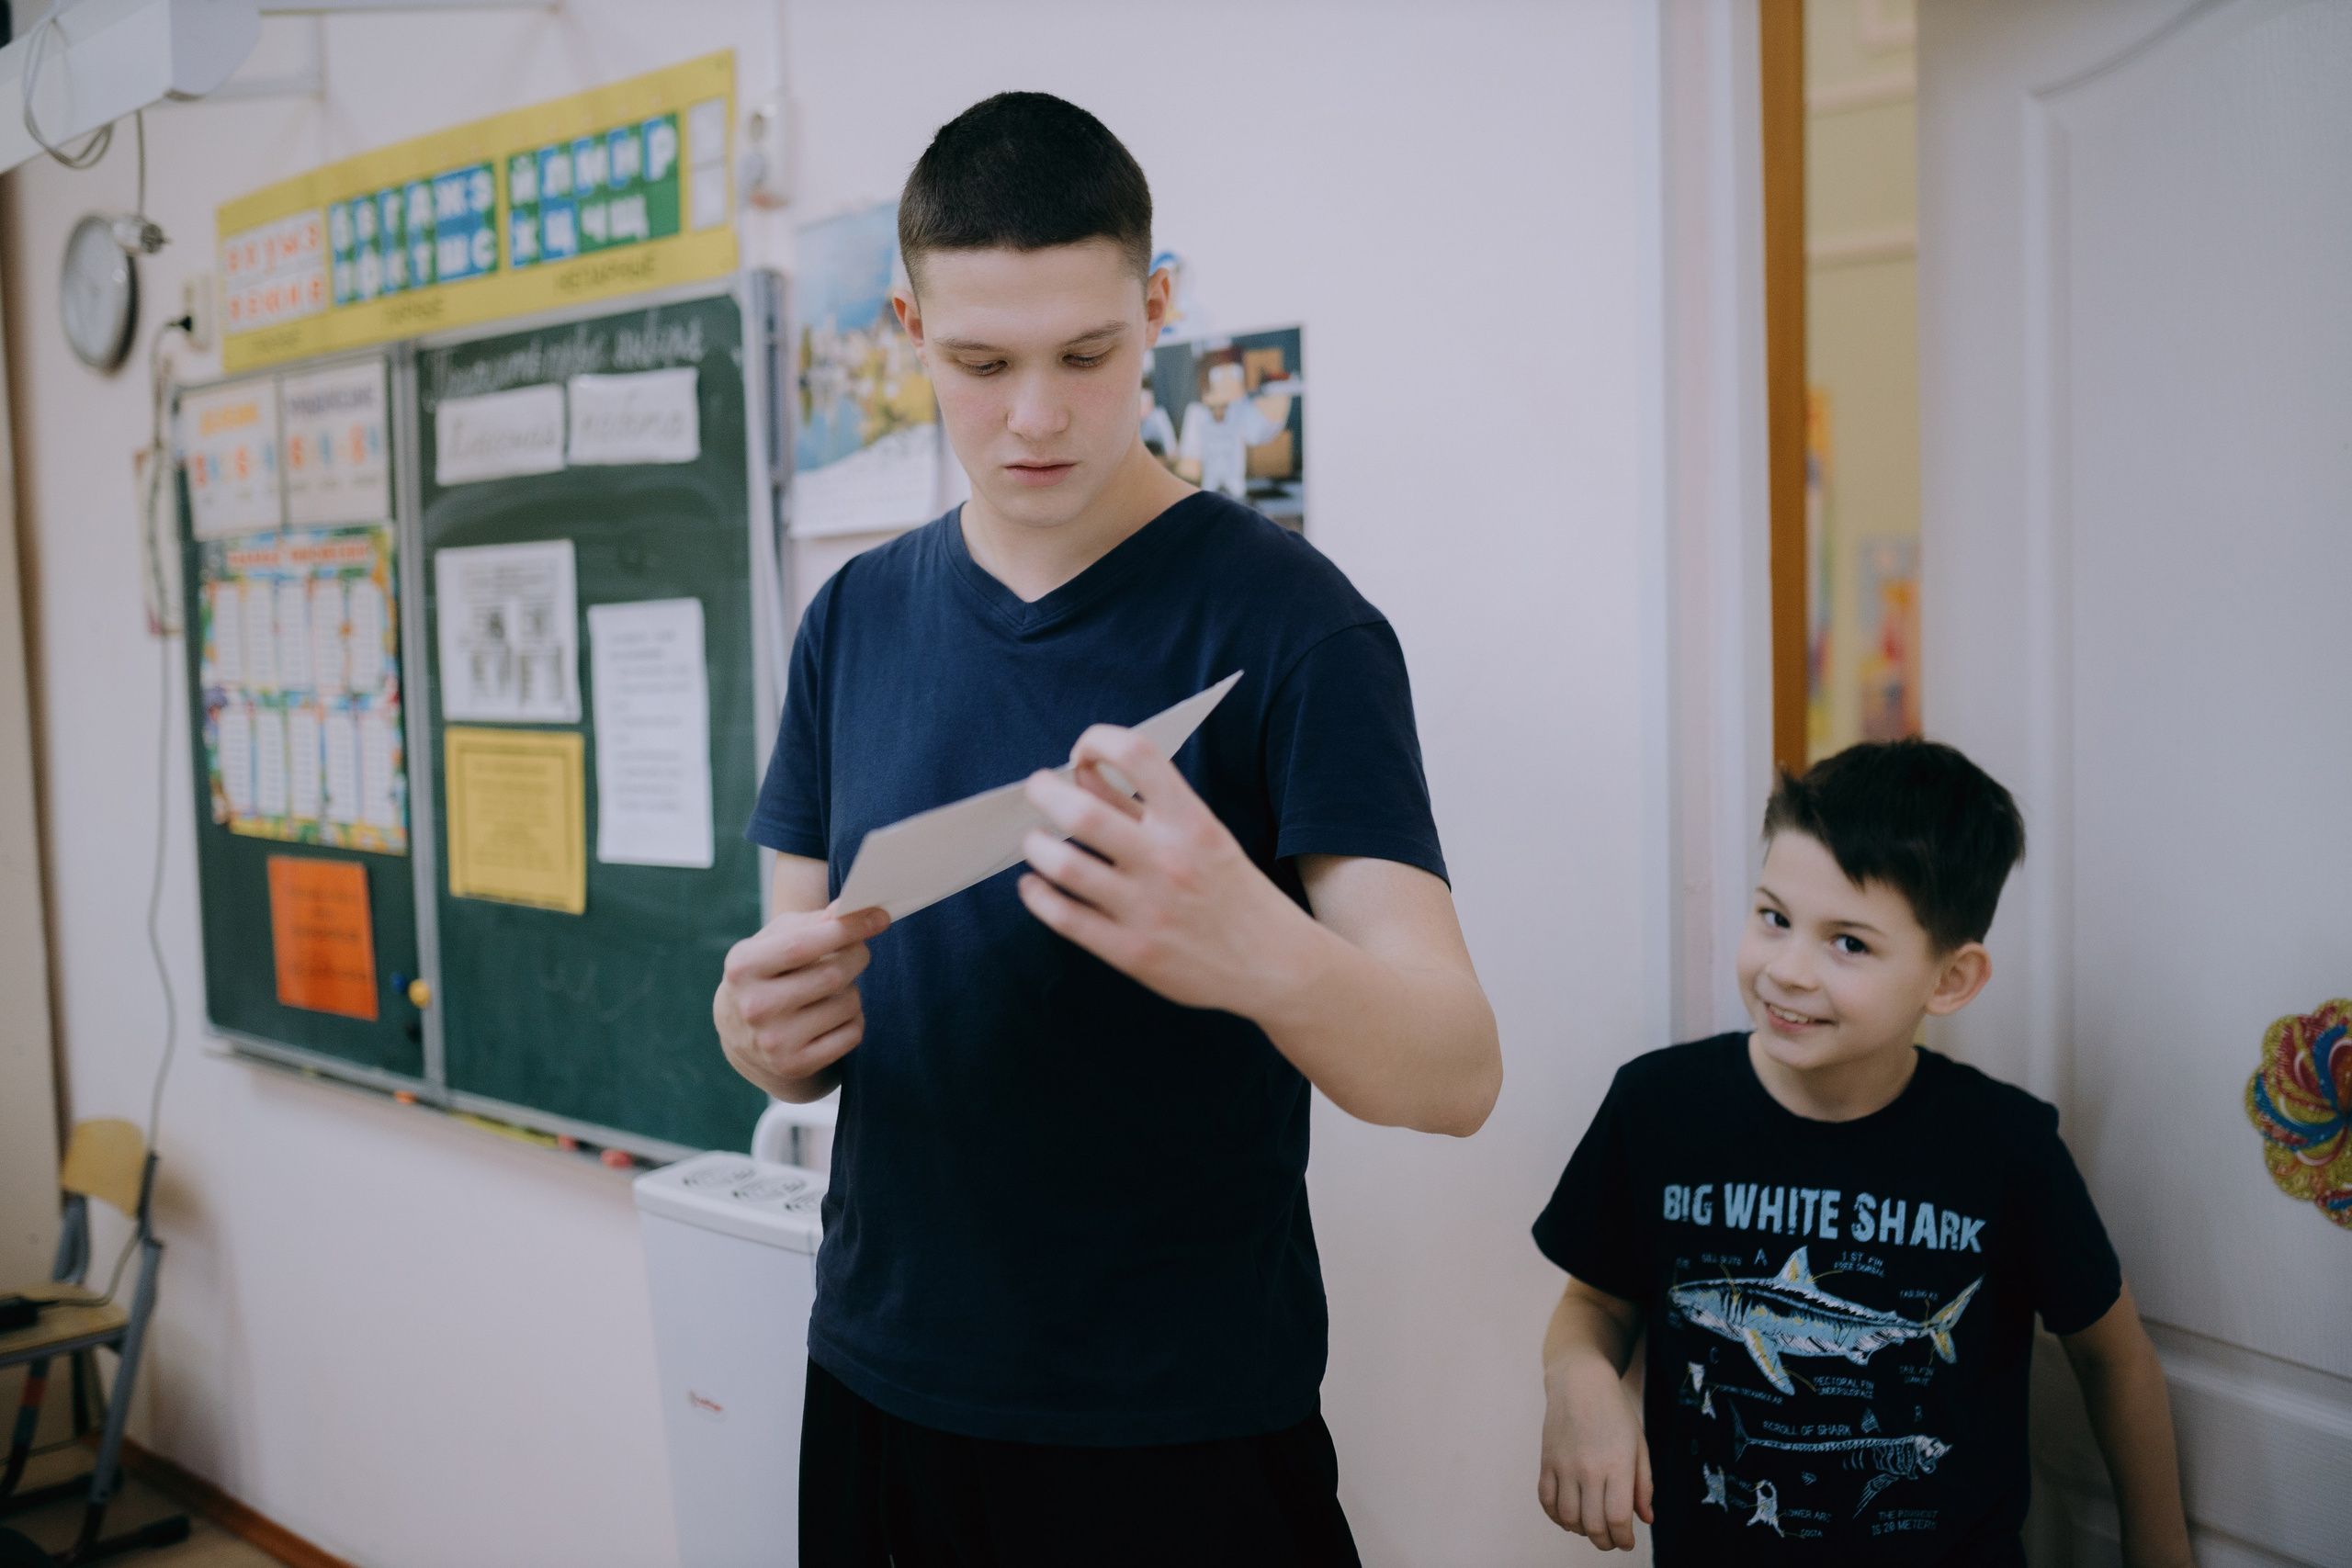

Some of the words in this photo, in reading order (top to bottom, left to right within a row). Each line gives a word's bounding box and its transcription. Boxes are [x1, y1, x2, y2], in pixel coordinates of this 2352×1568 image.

[1663, 1183, 1713, 1226] BIG
[1724, 1181, 1841, 1240] WHITE
[1850, 1191, 1986, 1254] SHARK
[1753, 1247, 1768, 1267] A
[1817, 1424, 1852, 1437] SHARK
